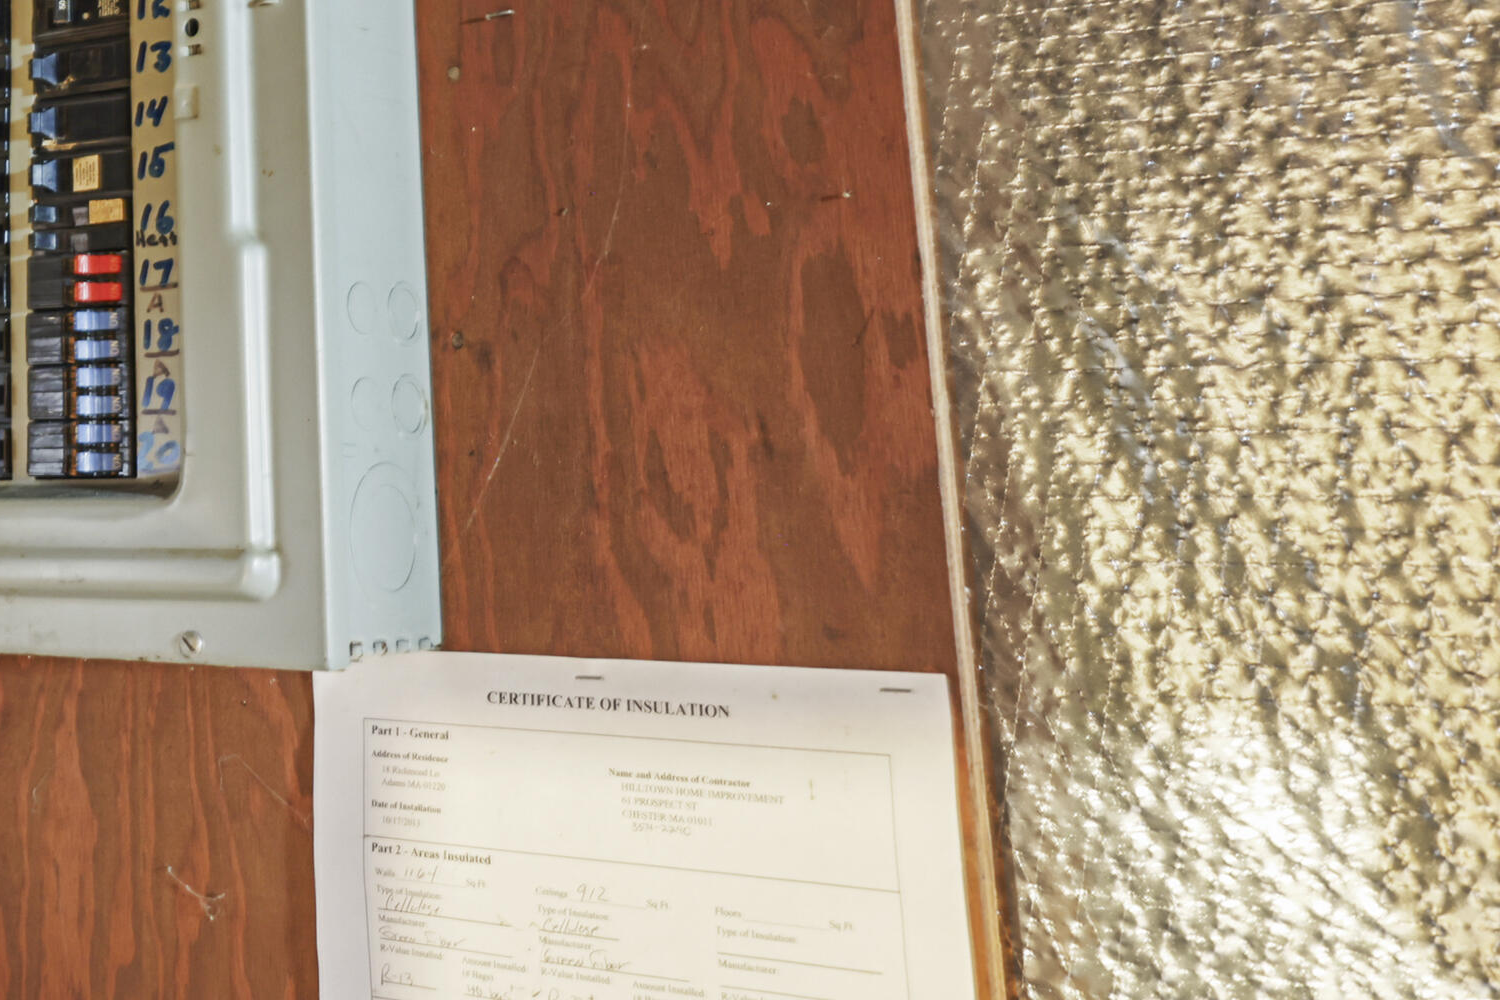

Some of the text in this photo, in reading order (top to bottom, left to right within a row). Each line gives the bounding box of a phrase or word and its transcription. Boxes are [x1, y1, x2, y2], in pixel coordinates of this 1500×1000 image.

[136, 40, 173, 73] 13
[135, 95, 169, 127] 14
[137, 141, 175, 181] 15
[140, 199, 174, 235] 16
[139, 258, 174, 287] 17
[109, 312, 119, 328] ON
[143, 317, 179, 351] 18
[110, 340, 120, 356] ON
[111, 368, 121, 384] ON
[111, 397, 121, 412] ON
[141, 376, 176, 411] 19
[136, 431, 180, 470] 20
[486, 690, 732, 719] CERTIFICATE OF INSULATION
[371, 724, 394, 738] Part
[409, 727, 450, 741] General
[371, 749, 449, 764] Address of Residence
[608, 767, 751, 788] Name and Address of Contractor
[620, 782, 785, 805] HILLTOWN HOME IMPROVEMENT
[370, 798, 442, 815] Date of Installation
[371, 842, 393, 854] Part
[394, 844, 402, 855] 2
[411, 847, 440, 861] Areas
[443, 850, 492, 866] Insulated
